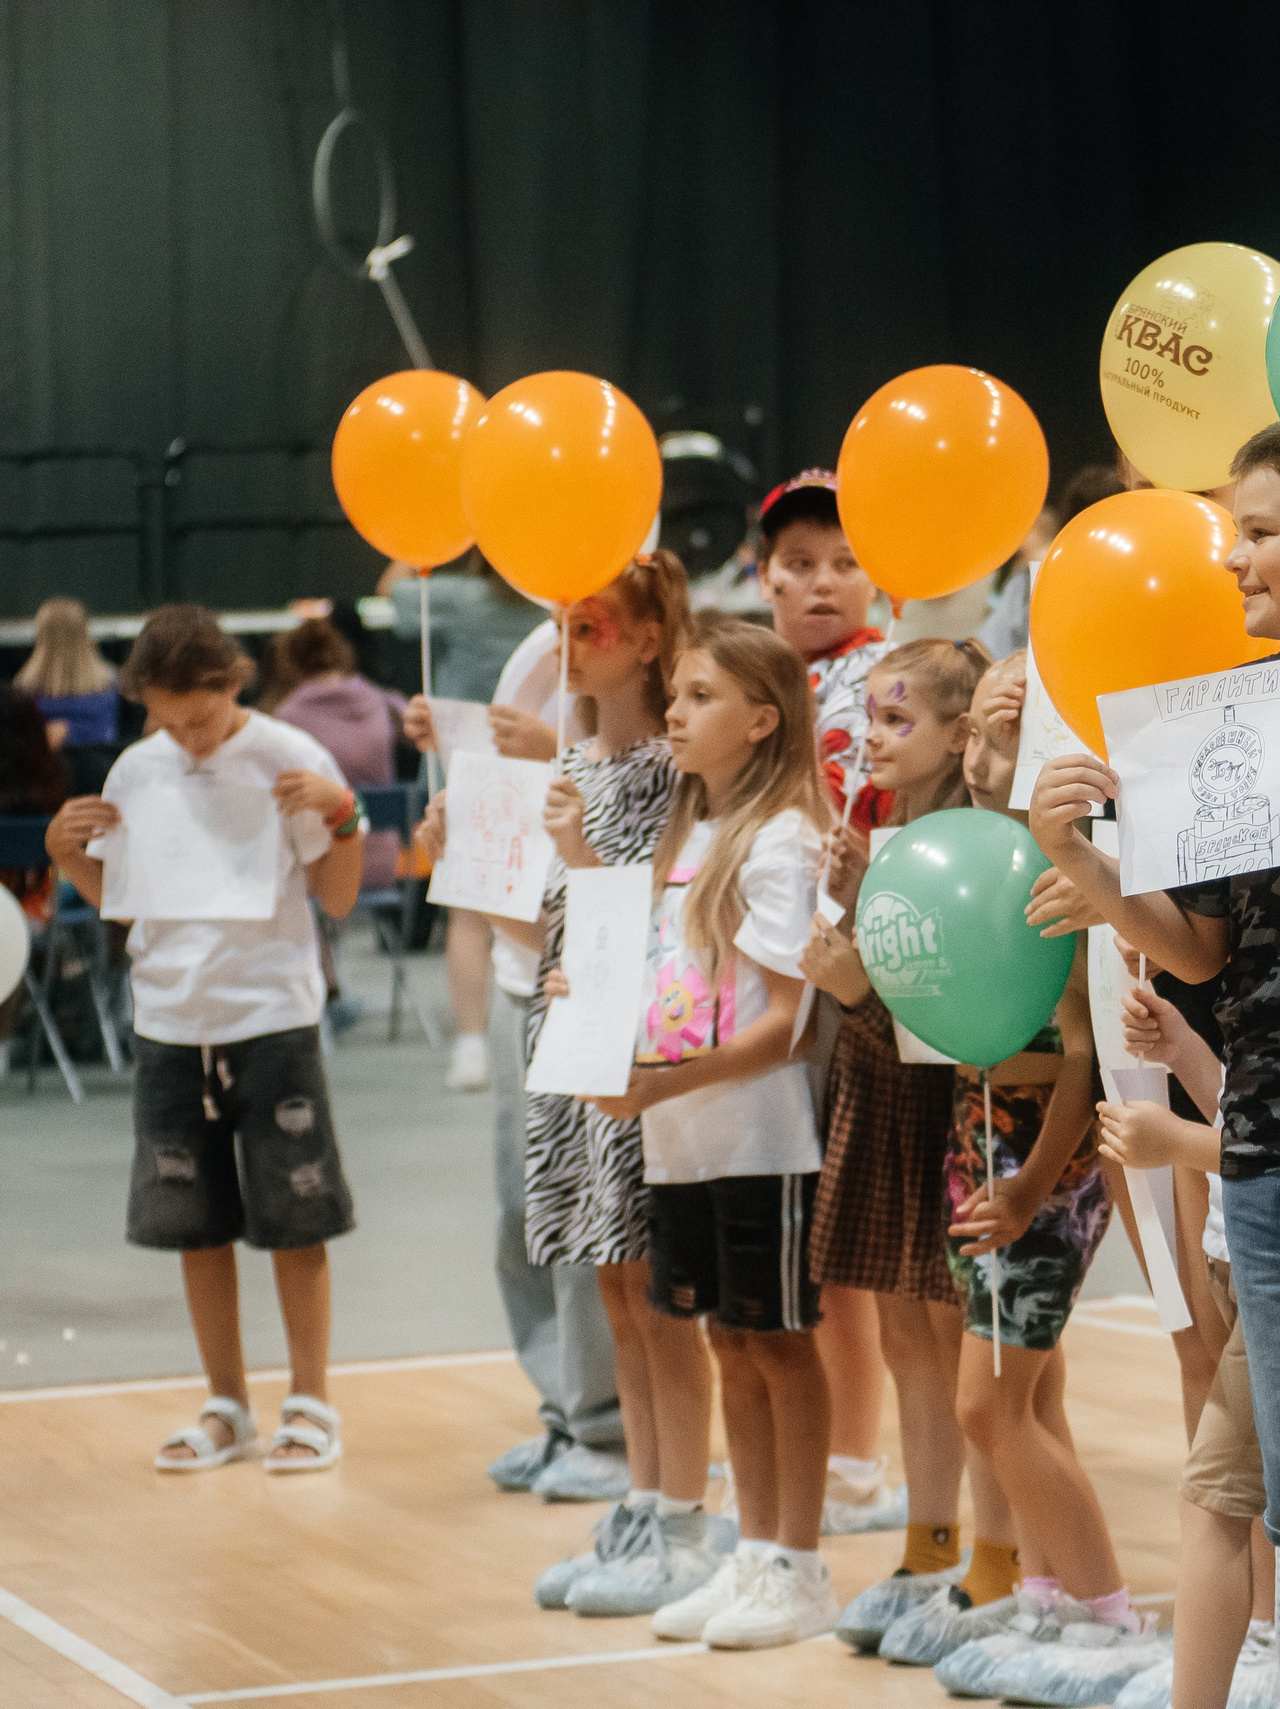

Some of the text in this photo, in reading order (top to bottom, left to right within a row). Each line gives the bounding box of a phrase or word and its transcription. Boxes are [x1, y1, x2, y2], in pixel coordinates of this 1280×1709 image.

[1128, 304, 1188, 334] БРЯНСКИЙ
[1115, 314, 1214, 377] КВАС
[1124, 357, 1165, 389] 100%
[1152, 392, 1202, 421] ПРОДУКТ
